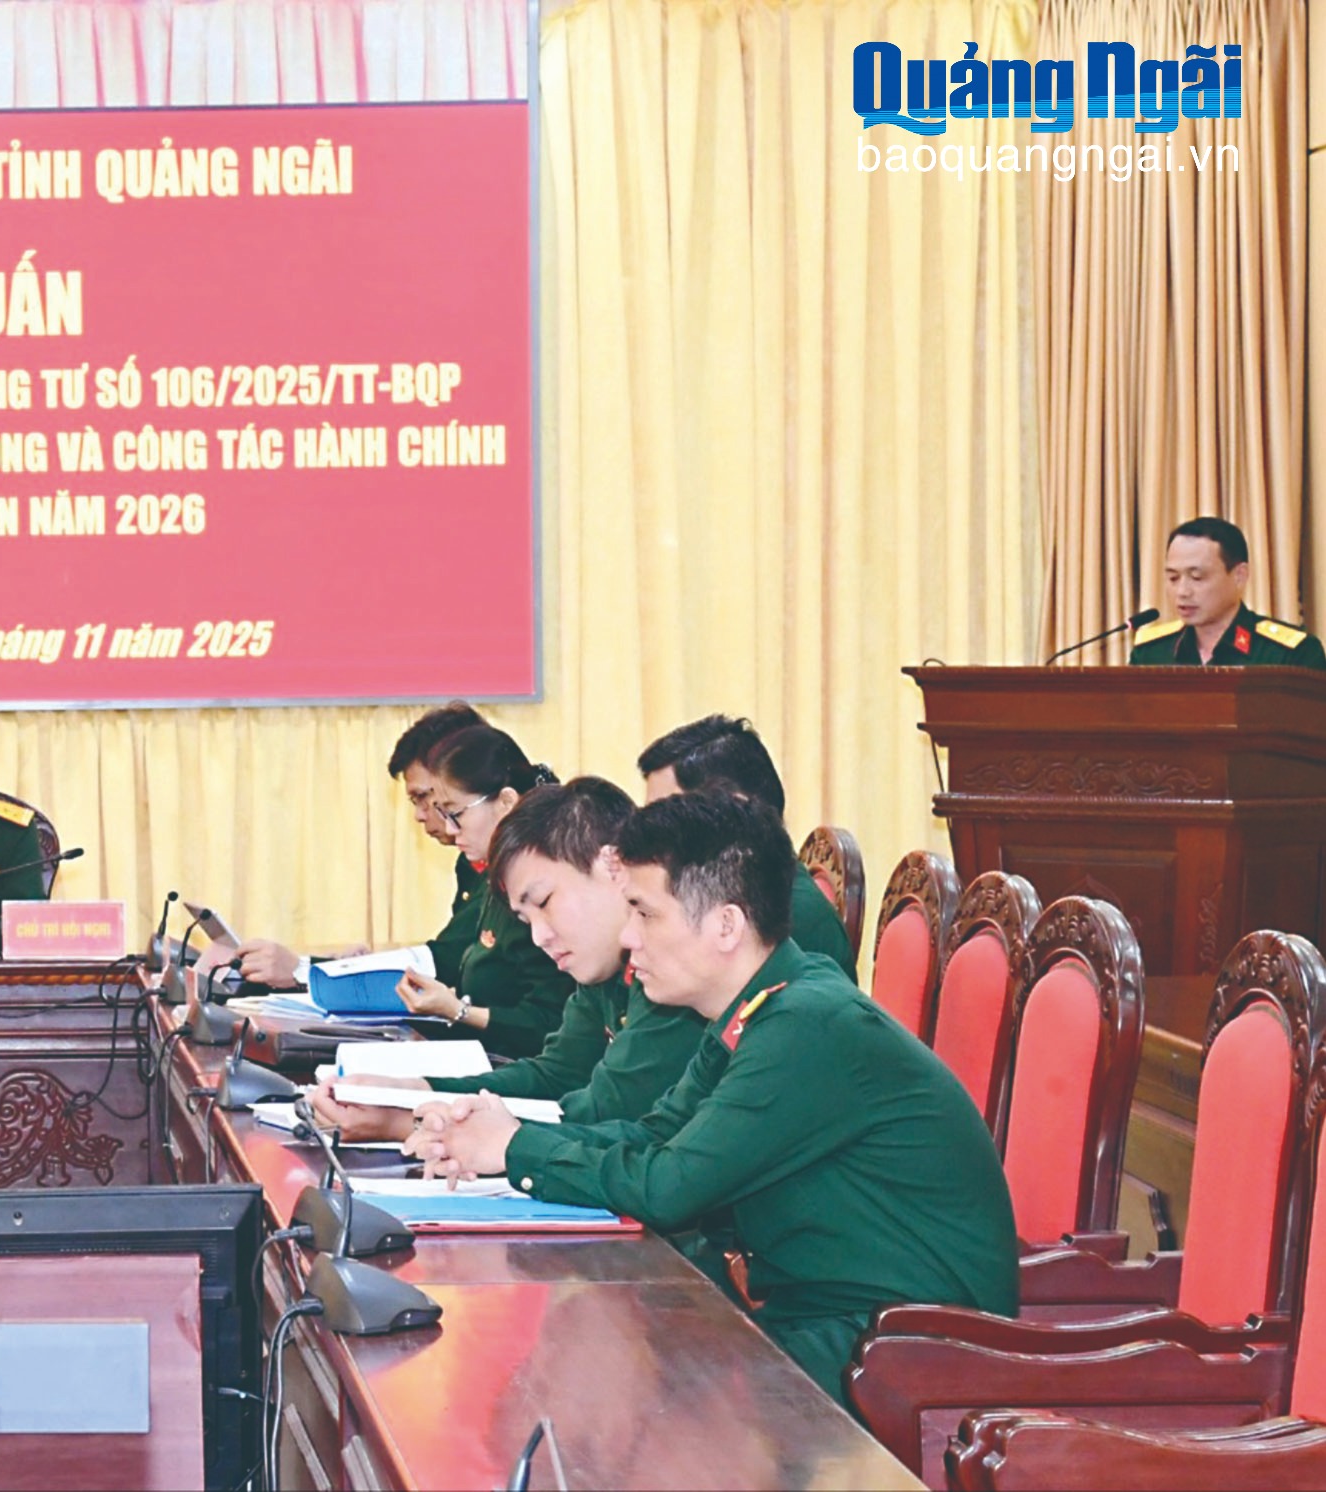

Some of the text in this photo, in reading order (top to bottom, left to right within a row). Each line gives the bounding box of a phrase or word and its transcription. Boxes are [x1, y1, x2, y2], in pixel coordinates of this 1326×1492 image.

[95, 136, 239, 204] QUẢNG
[252, 138, 353, 198] NGÃI
[39, 362, 90, 410] TƯ
[94, 354, 142, 409] SỐ
[150, 361, 462, 408] 106/2025/TT-BQP
[56, 425, 105, 472] VÀ
[112, 424, 208, 472] CÔNG
[216, 422, 284, 470] TÁC
[293, 421, 388, 469] HÀNH
[397, 419, 506, 468] CHÍNH
[29, 489, 106, 536] NĂM
[115, 493, 206, 536] 2026
[72, 623, 107, 659] 11
[107, 622, 184, 659] năm
[186, 620, 275, 658] 2025
